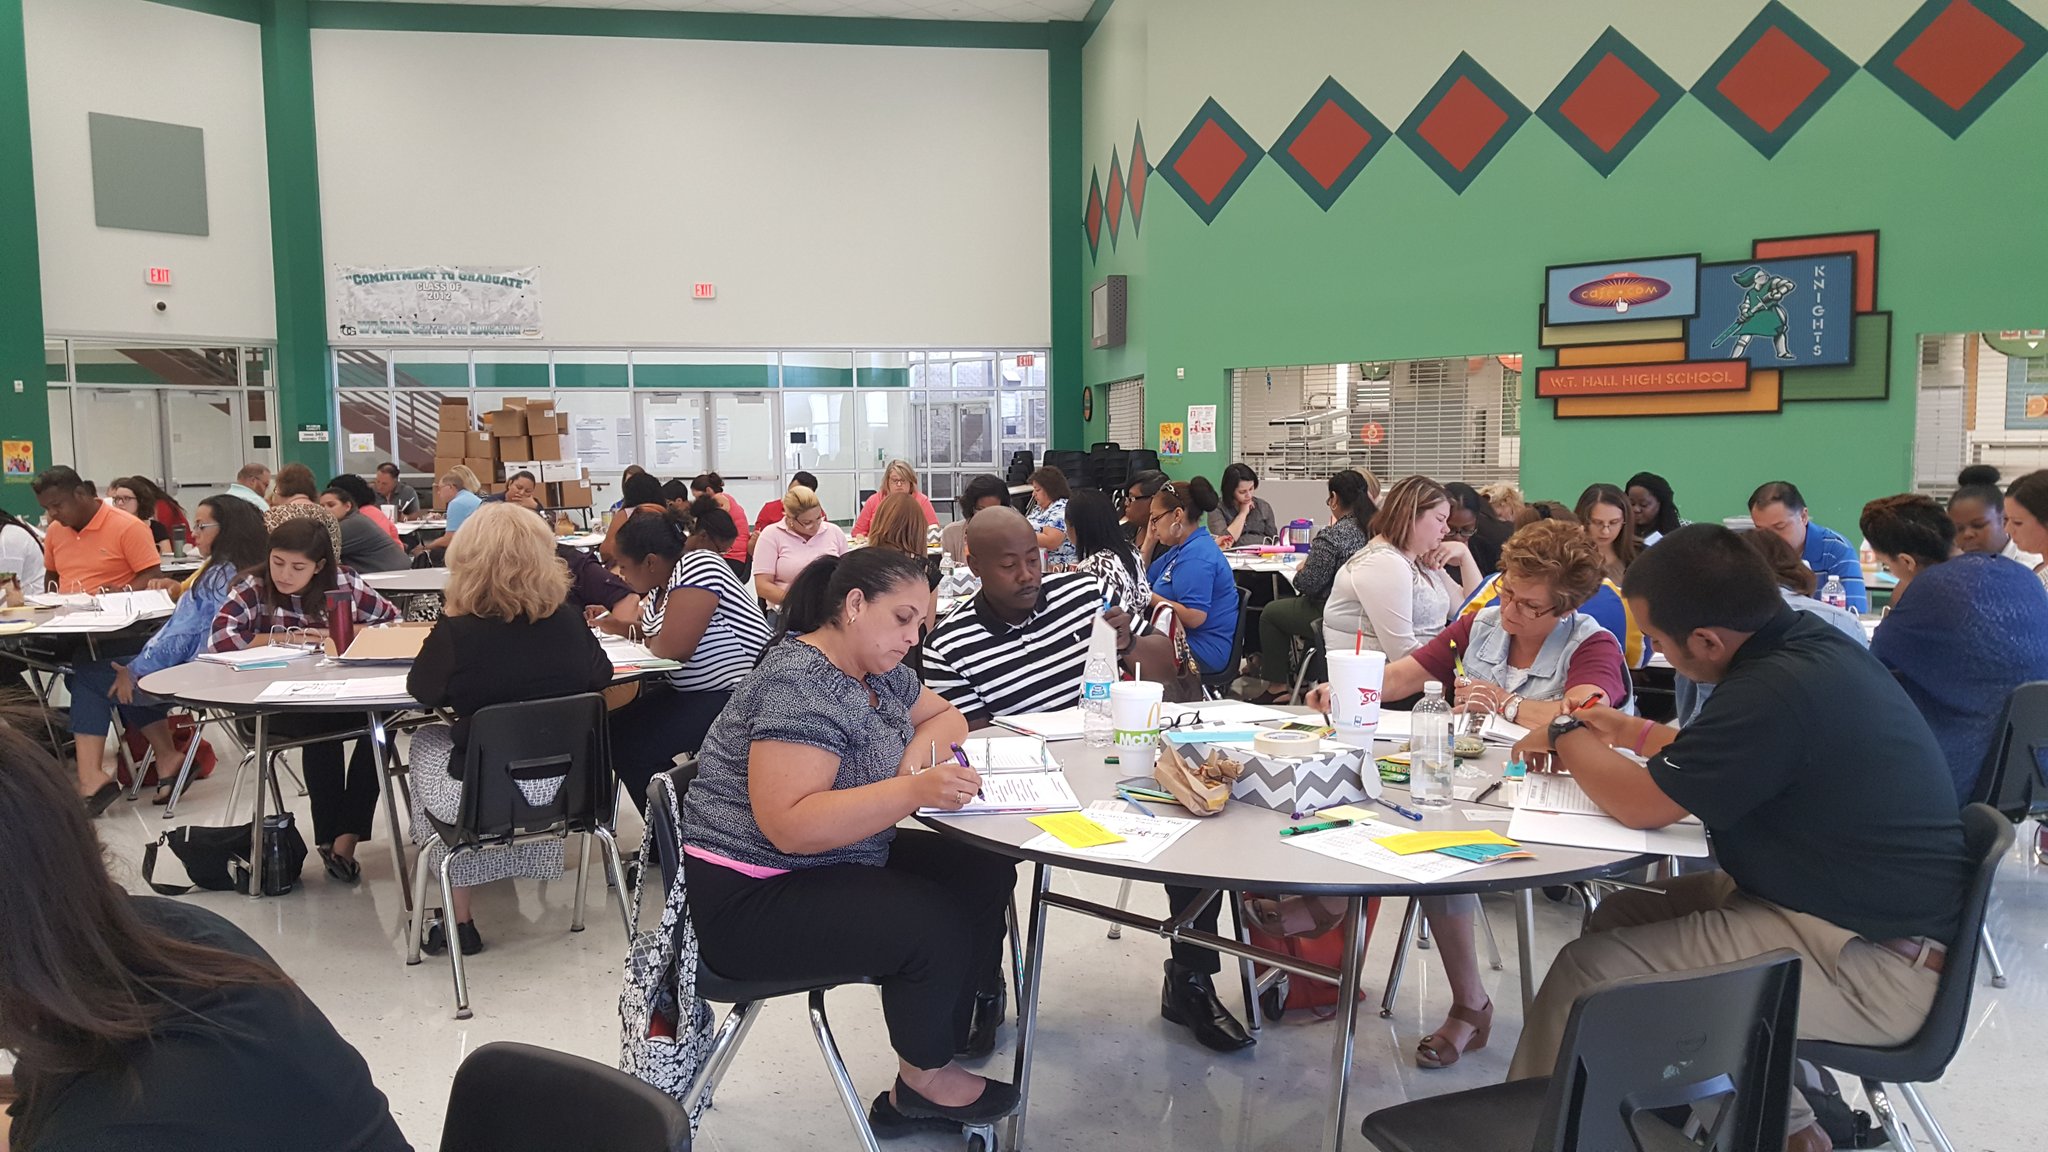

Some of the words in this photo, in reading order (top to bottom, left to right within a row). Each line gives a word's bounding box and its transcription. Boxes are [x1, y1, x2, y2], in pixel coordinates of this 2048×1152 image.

[151, 267, 169, 283] EXIT
[416, 282, 447, 292] CLASS
[449, 282, 463, 292] OF
[695, 283, 712, 297] EXIT
[427, 291, 451, 301] 2012
[1812, 265, 1825, 356] KNIGHTS
[1550, 376, 1578, 388] W.T.
[1582, 374, 1618, 387] HALL
[1622, 373, 1662, 386] HIGH
[1666, 371, 1732, 385] SCHOOL
